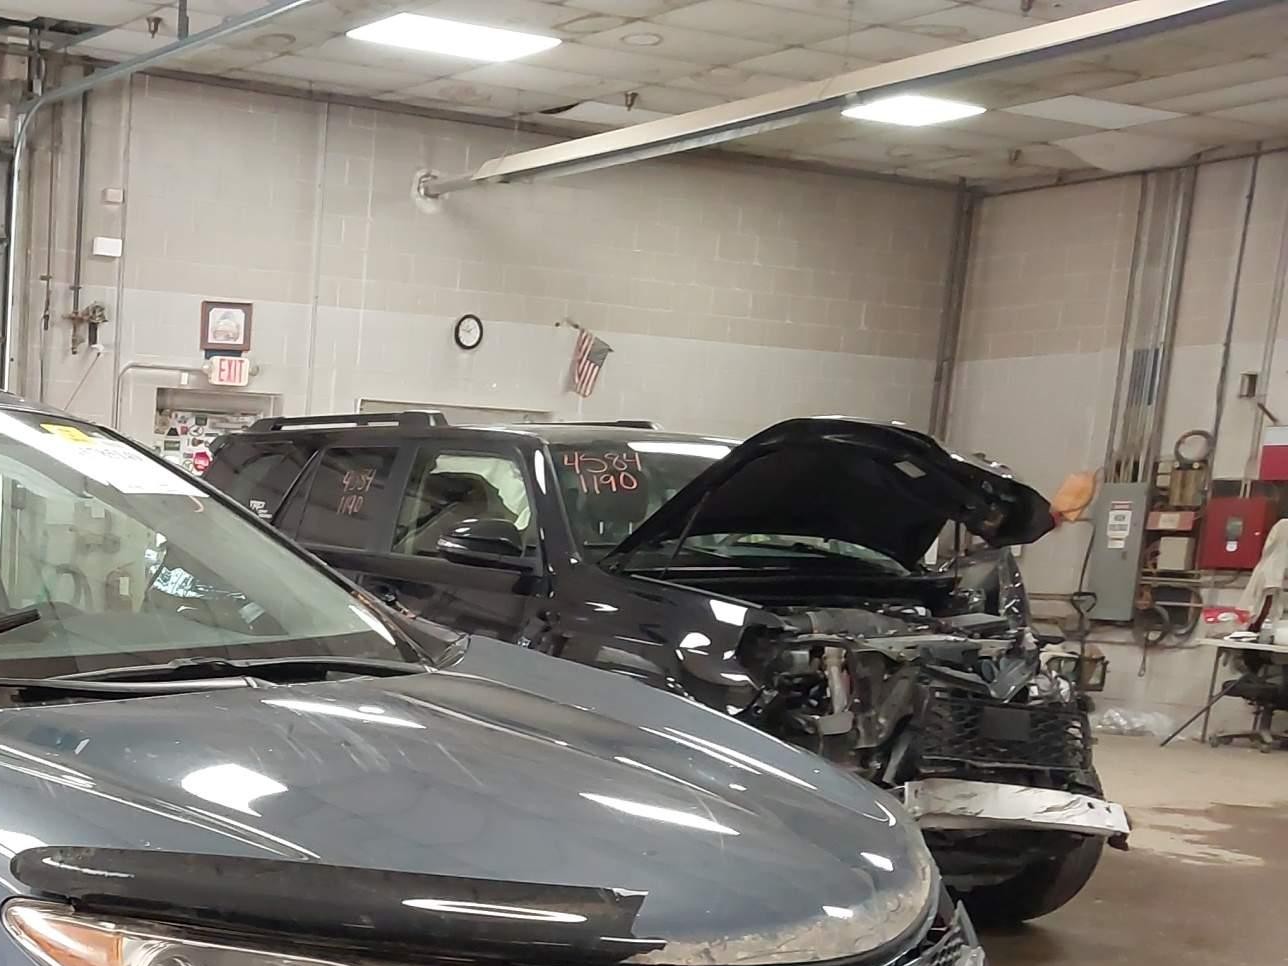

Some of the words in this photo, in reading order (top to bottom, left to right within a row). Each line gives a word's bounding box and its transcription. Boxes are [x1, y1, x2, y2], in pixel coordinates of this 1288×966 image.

[218, 358, 244, 384] EXIT
[563, 451, 642, 474] 4584
[343, 469, 377, 492] 44
[579, 471, 638, 494] 1190
[336, 495, 364, 515] 1190
